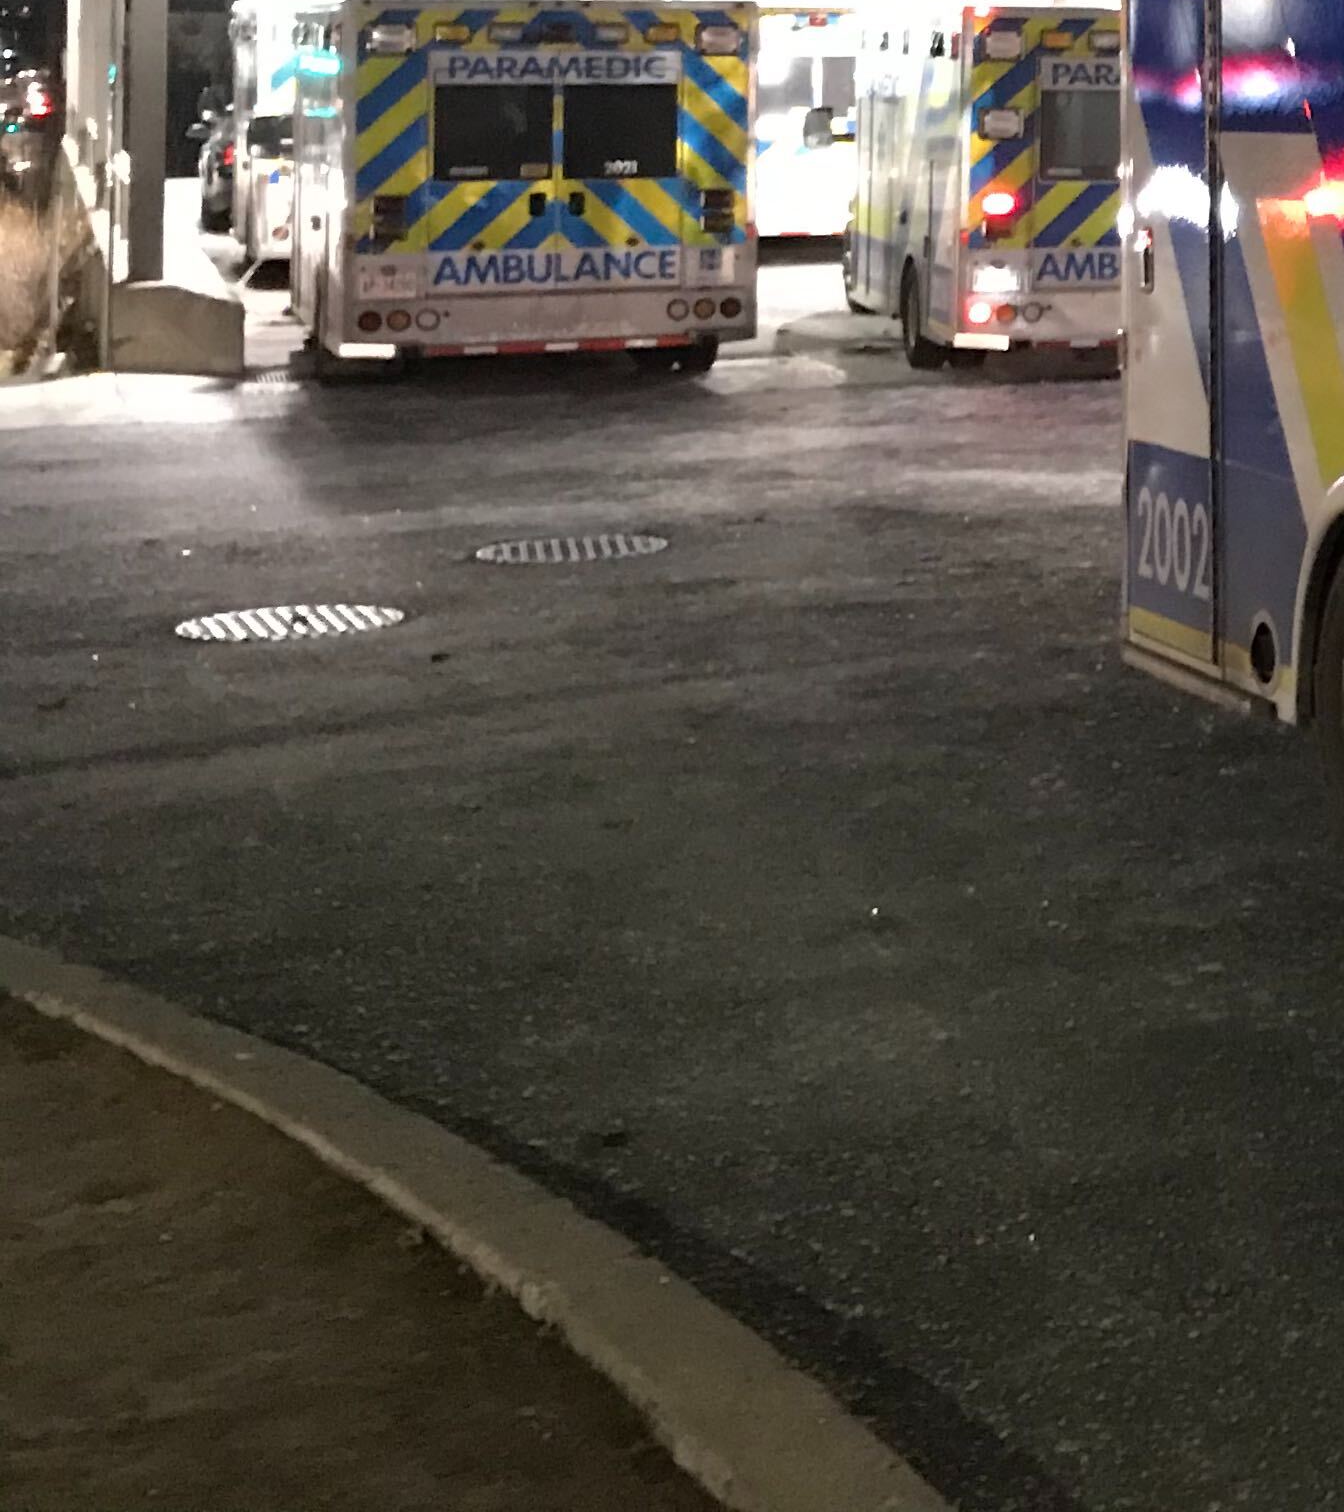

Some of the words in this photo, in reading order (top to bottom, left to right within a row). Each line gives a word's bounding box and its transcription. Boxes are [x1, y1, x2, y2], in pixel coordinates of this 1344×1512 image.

[447, 55, 668, 80] PARAMEDIC
[1051, 62, 1120, 87] PAR
[432, 250, 678, 285] AMBULANCE
[1137, 486, 1209, 600] 2002
